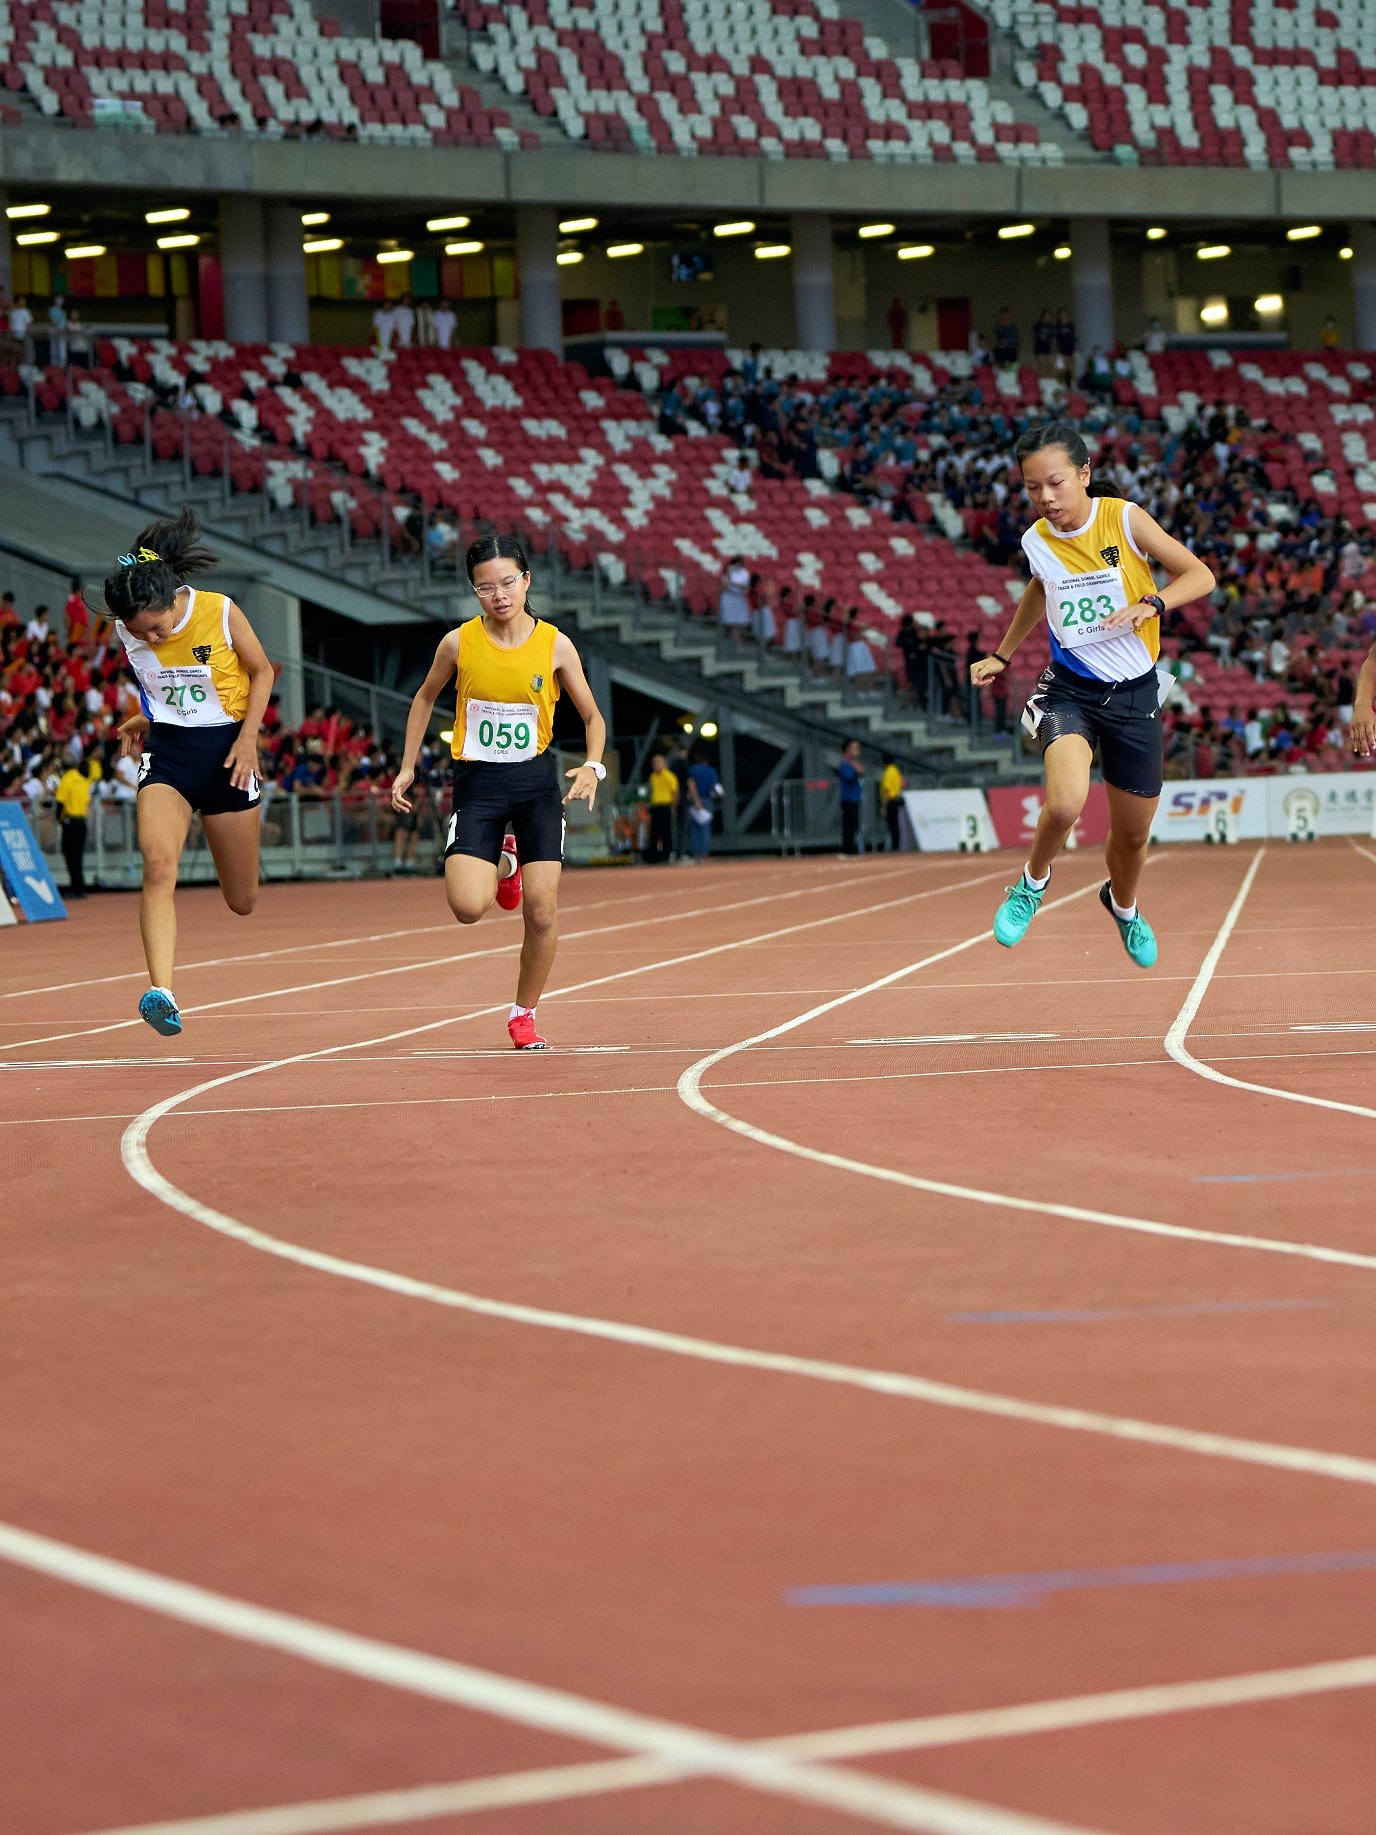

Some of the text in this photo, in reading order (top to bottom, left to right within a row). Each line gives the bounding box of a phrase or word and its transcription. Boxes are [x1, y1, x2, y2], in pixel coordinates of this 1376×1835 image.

[1060, 594, 1115, 627] 283
[1086, 625, 1106, 634] Girls
[161, 684, 207, 707] 276
[181, 708, 198, 716] Girls
[479, 719, 530, 749] 059
[1295, 807, 1308, 831] 5
